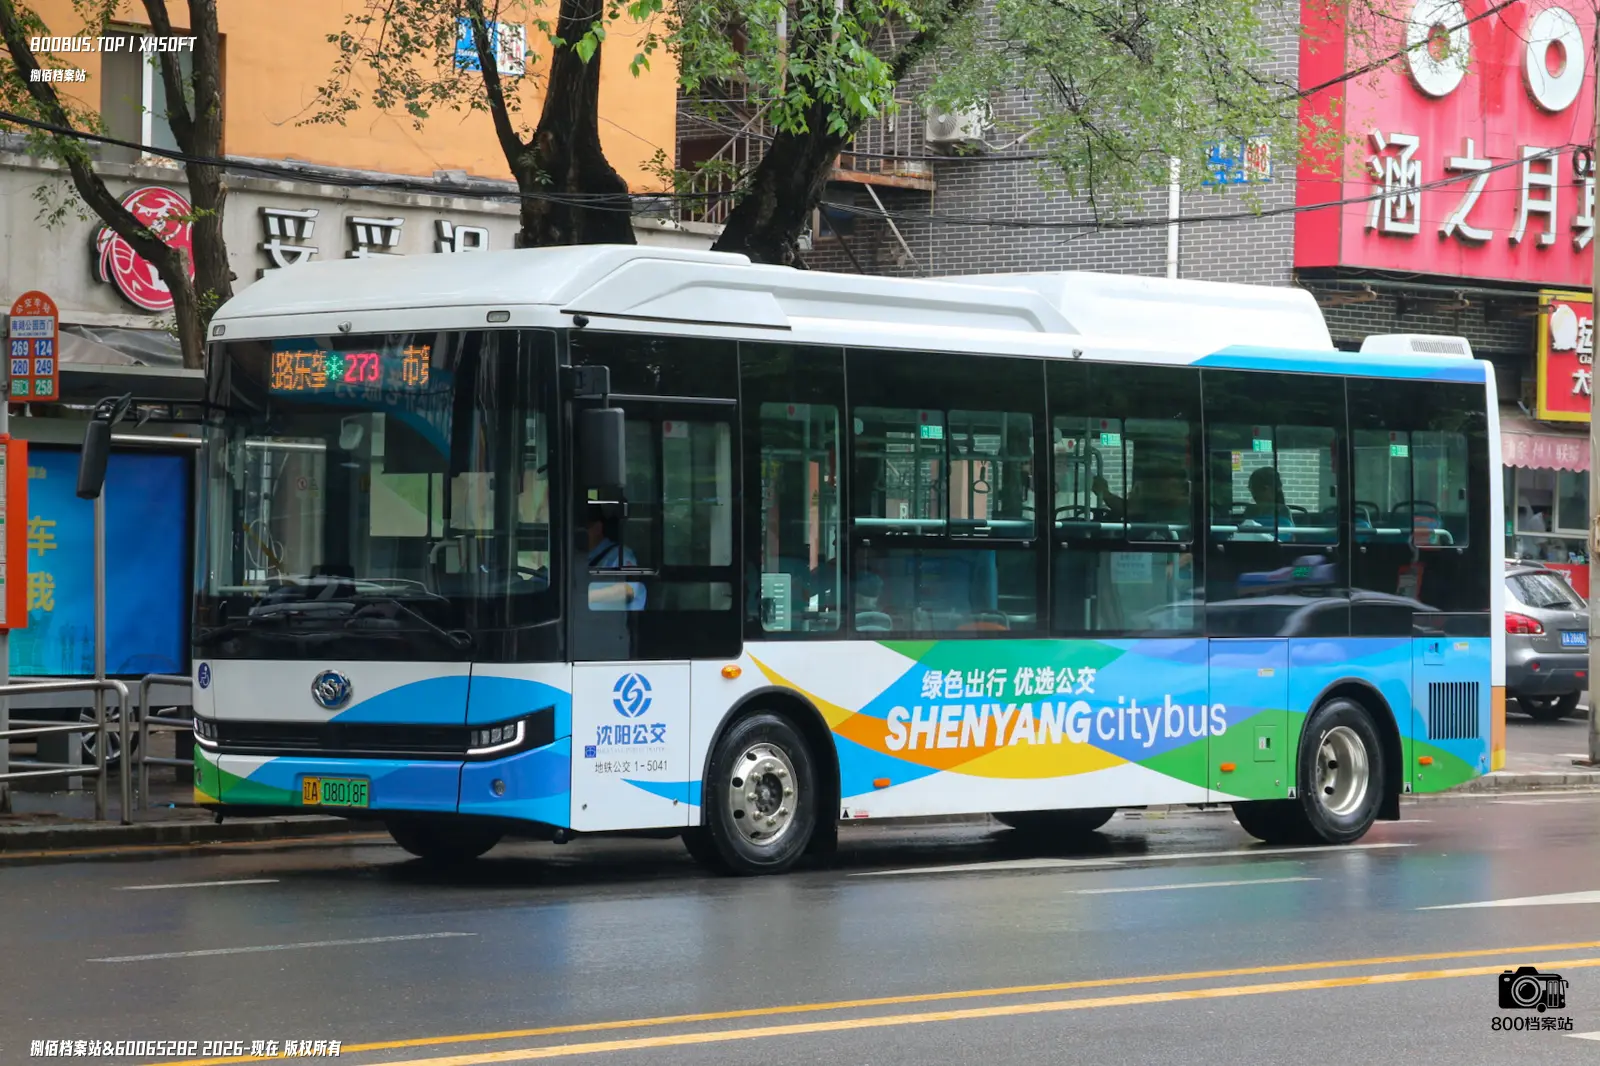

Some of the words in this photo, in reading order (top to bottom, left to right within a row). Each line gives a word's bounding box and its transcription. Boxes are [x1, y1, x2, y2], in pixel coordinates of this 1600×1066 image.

[12, 341, 29, 356] 269
[35, 341, 52, 356] 124
[13, 360, 28, 374] 280
[36, 359, 52, 374] 249
[344, 353, 380, 382] 273
[35, 380, 52, 395] 258
[921, 669, 1007, 699] 绿色出行
[1013, 666, 1097, 697] 优选公交
[885, 700, 1091, 751] SHENYANG
[1096, 694, 1227, 747] citybus
[596, 723, 667, 746] 沈阳公交
[595, 761, 631, 774] 地铁公交
